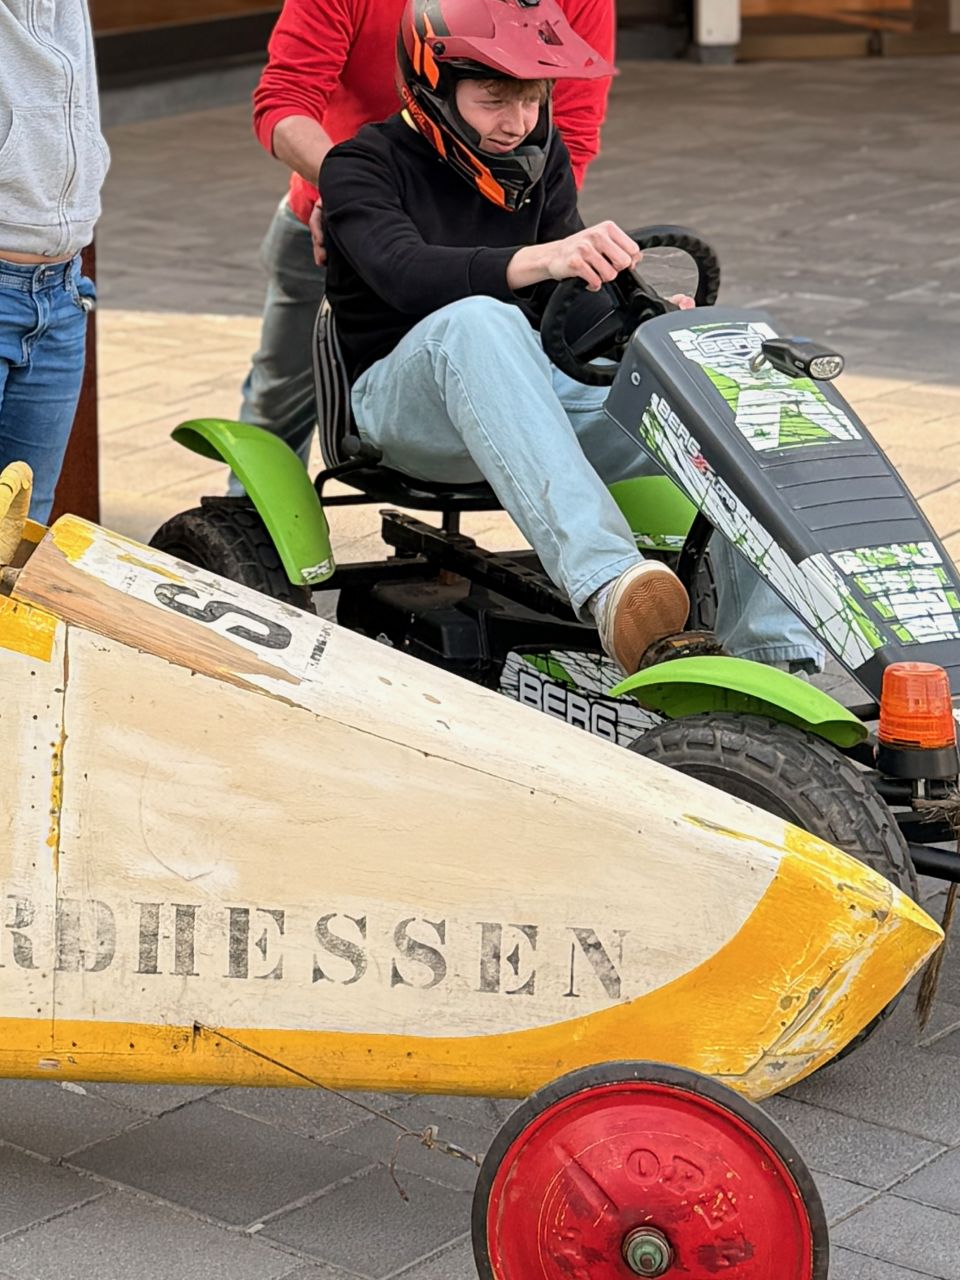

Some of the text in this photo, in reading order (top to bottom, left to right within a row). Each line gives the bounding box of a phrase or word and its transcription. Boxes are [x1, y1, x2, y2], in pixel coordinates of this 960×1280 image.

[696, 336, 764, 354] BERG
[656, 397, 702, 458] BERG
[518, 670, 619, 744] BERG
